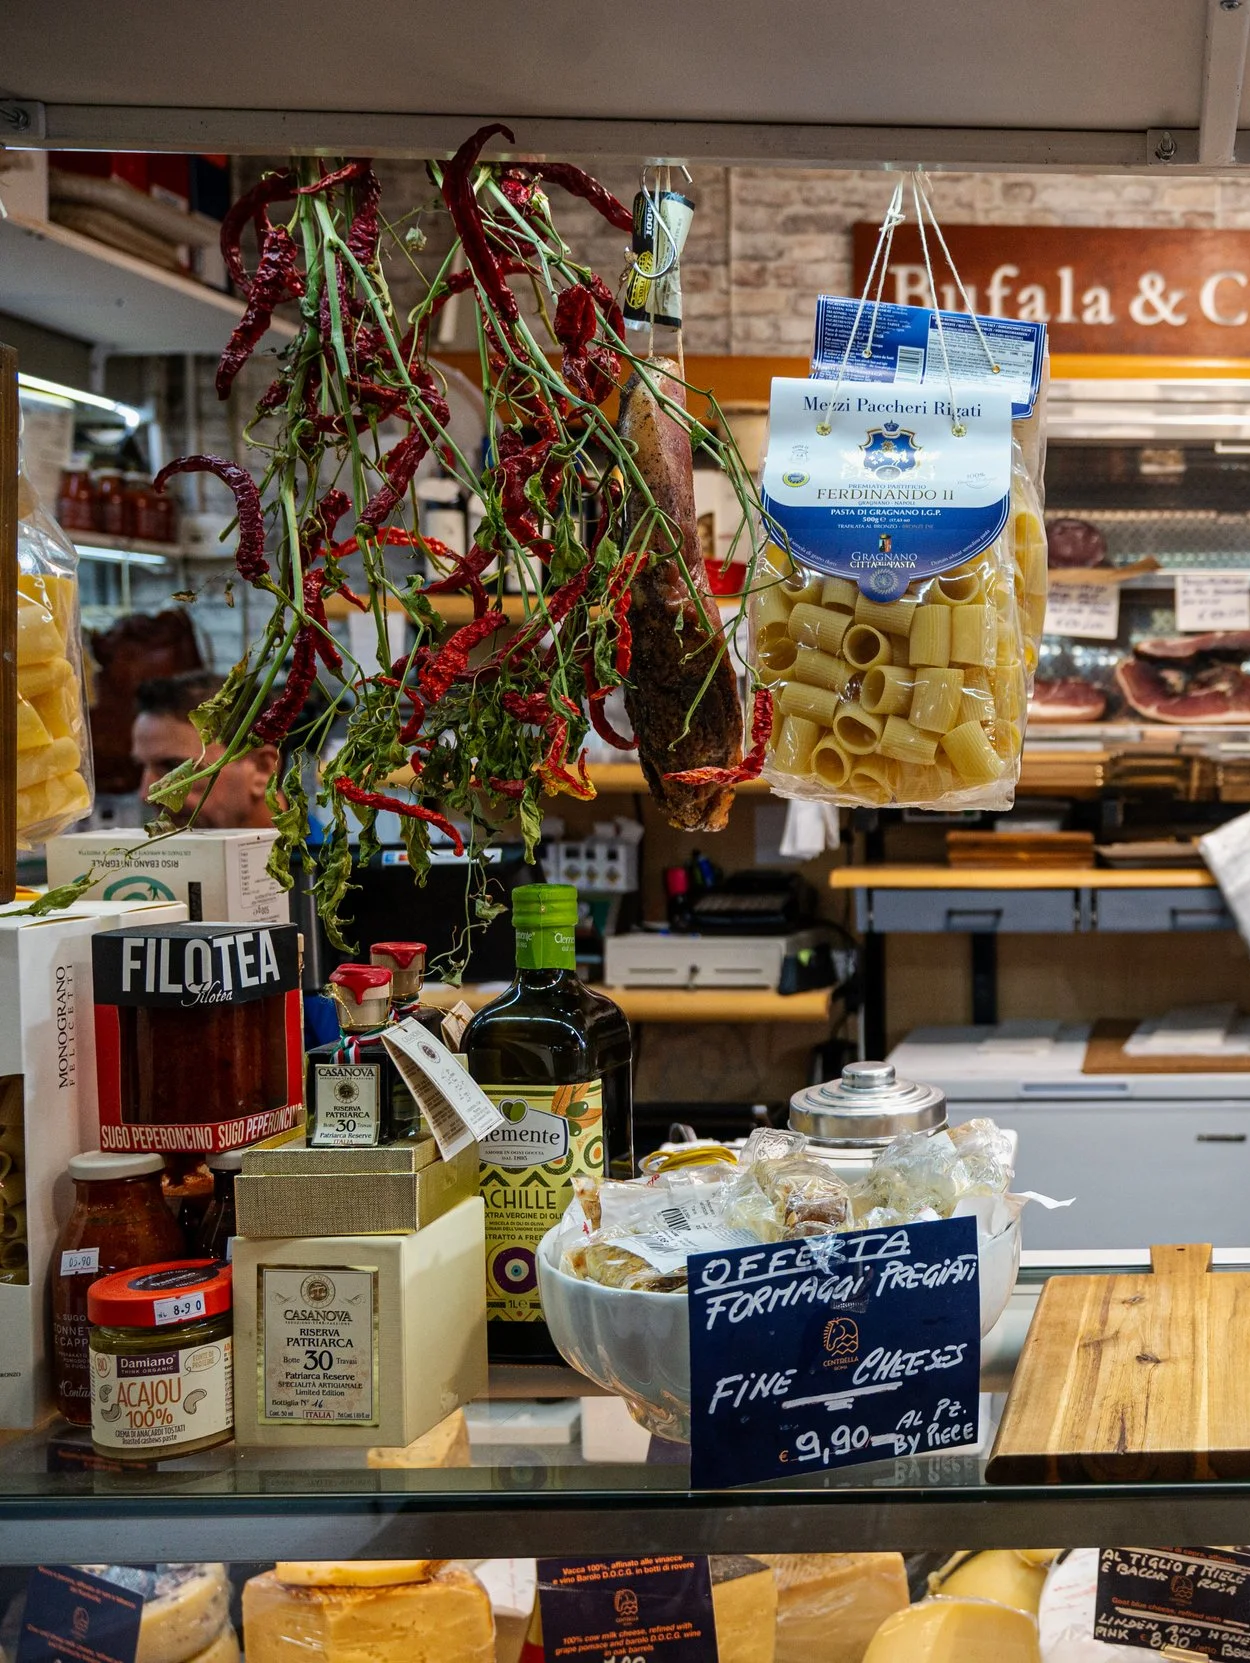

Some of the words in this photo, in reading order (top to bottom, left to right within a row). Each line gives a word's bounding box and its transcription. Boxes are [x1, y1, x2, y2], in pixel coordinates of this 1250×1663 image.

[888, 264, 1114, 325] Bufala
[1131, 271, 1186, 327] &
[804, 396, 850, 412] Mezzi
[857, 398, 927, 414] Paccheri
[934, 401, 982, 420] Rigati
[817, 489, 937, 501] FERDINANDO
[943, 490, 954, 501] II
[851, 552, 918, 561] GRAGNANO
[134, 859, 160, 868] EBANO
[161, 859, 179, 868] RISO
[122, 929, 281, 994] FILOTEA
[181, 981, 233, 1007] Filotea
[55, 966, 69, 1089] MONOGRANO
[67, 963, 76, 1087] FELICETTI
[318, 1067, 376, 1077] CASANOVA
[325, 1111, 370, 1119] PATRIARCA
[101, 1125, 131, 1149] SUGO
[132, 1126, 213, 1150] PEPERONCINO
[218, 1120, 245, 1147] SUGO
[335, 1119, 357, 1133] 30
[479, 1128, 561, 1146] emente
[480, 1189, 557, 1209] ACHILLE
[705, 1265, 869, 1330] FORMAGGI
[877, 1254, 978, 1297] PREGIATI
[283, 1309, 353, 1323] CASANOVA
[286, 1337, 354, 1348] PATRIARCA
[299, 1328, 340, 1337] RISERVA
[97, 1358, 108, 1373] BIO
[142, 1366, 174, 1374] ORGANIC
[283, 1356, 301, 1364] Botte
[303, 1350, 334, 1371] 30
[336, 1357, 358, 1365] Travasi
[822, 1355, 860, 1368] CENTRELLA
[277, 1380, 317, 1389] SPECIALITÀ
[318, 1382, 363, 1390] ARTIGIANALE
[285, 1371, 321, 1380] Patriarca
[322, 1372, 355, 1381] Reserve
[708, 1368, 798, 1415] FINE
[852, 1343, 968, 1386] CHEESES
[116, 1376, 181, 1410] ACAJOU
[295, 1388, 321, 1397] Limited
[322, 1389, 345, 1397] Edition
[271, 1399, 299, 1408] Bottiglia
[125, 1408, 173, 1428] 100%
[305, 1411, 332, 1419] ITALIA
[895, 1409, 923, 1431] AL
[115, 1430, 131, 1439] CREMA
[131, 1430, 137, 1438] DI
[136, 1427, 164, 1438] ANACARDI
[164, 1424, 186, 1435] TOSTATI
[140, 1437, 162, 1445] cashews
[162, 1434, 178, 1444] paste
[779, 1450, 789, 1463] €
[795, 1424, 870, 1464] 9,90
[893, 1434, 920, 1456] BY
[562, 1566, 586, 1576] Vacca
[587, 1563, 610, 1573] 100%,
[611, 1560, 639, 1570] affinato
[640, 1558, 654, 1566] alle
[655, 1554, 684, 1564] vinacce
[1101, 1549, 1122, 1562] AL
[1129, 1550, 1183, 1572] TIGLIO
[559, 1576, 575, 1585] vino
[576, 1572, 601, 1582] Barolo
[602, 1569, 634, 1579] D.O.C.G.
[635, 1567, 643, 1575] in
[644, 1564, 661, 1574] botti
[662, 1562, 670, 1571] di
[671, 1561, 695, 1571] rovere
[1101, 1562, 1112, 1573] E
[1197, 1578, 1238, 1596] ROSA
[1111, 1596, 1131, 1606] Goat
[1131, 1600, 1151, 1609] blue
[1178, 1609, 1205, 1619] refined
[1205, 1614, 1223, 1623] with
[562, 1636, 583, 1645] 100%
[584, 1634, 600, 1642] cow
[601, 1630, 617, 1641] milk
[649, 1623, 676, 1635] refined
[676, 1621, 693, 1631] with
[1095, 1626, 1129, 1640] PINK
[1098, 1612, 1159, 1631] LINDEN
[1165, 1624, 1202, 1637] AND
[555, 1645, 577, 1656] grape
[577, 1642, 609, 1653] pomace
[609, 1639, 624, 1648] and
[625, 1635, 649, 1646] barolo
[684, 1630, 701, 1639] wine
[603, 1649, 612, 1657] in
[613, 1646, 627, 1656] oak
[628, 1644, 655, 1654] barrels
